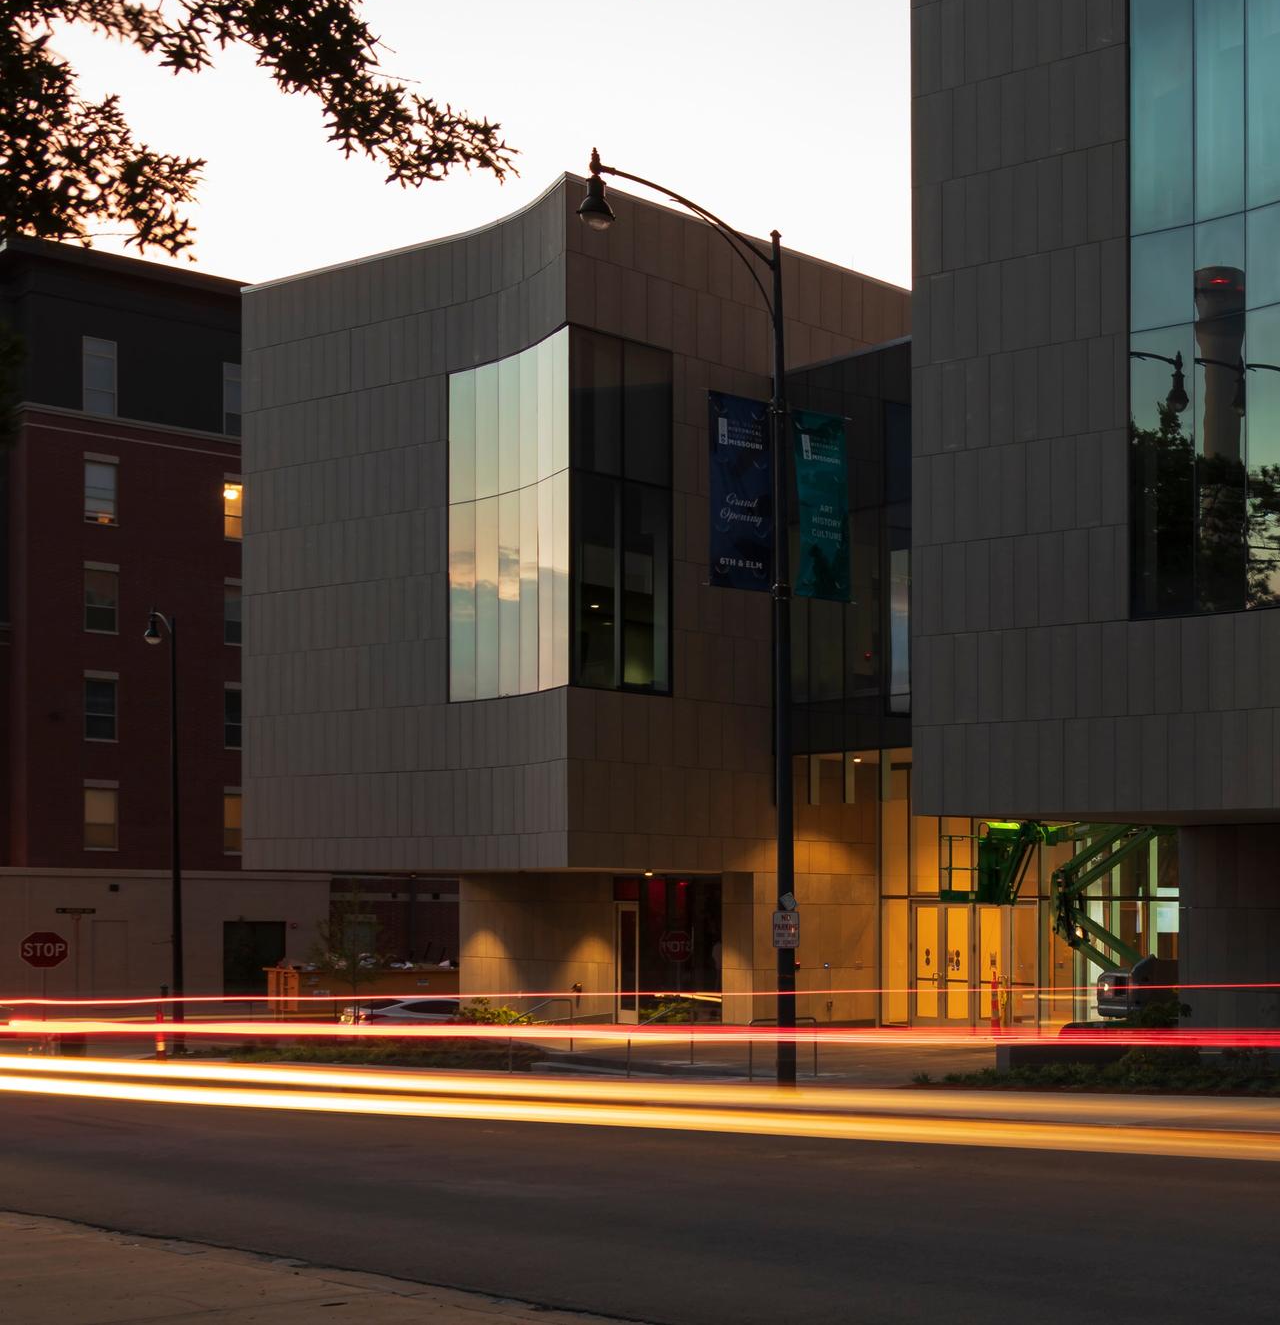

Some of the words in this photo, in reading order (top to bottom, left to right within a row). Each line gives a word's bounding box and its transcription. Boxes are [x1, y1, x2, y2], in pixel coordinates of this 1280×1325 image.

[728, 438, 763, 450] MISSOURI
[811, 453, 841, 466] MISSOURI
[726, 492, 759, 507] Grand
[820, 504, 833, 515] ART
[720, 506, 762, 527] Opening
[811, 515, 841, 528] HISTORY
[811, 528, 842, 541] CULTURE
[719, 557, 736, 566] 6TH
[745, 560, 763, 570] ELM
[774, 923, 799, 931] PARKING
[23, 942, 66, 957] STOP
